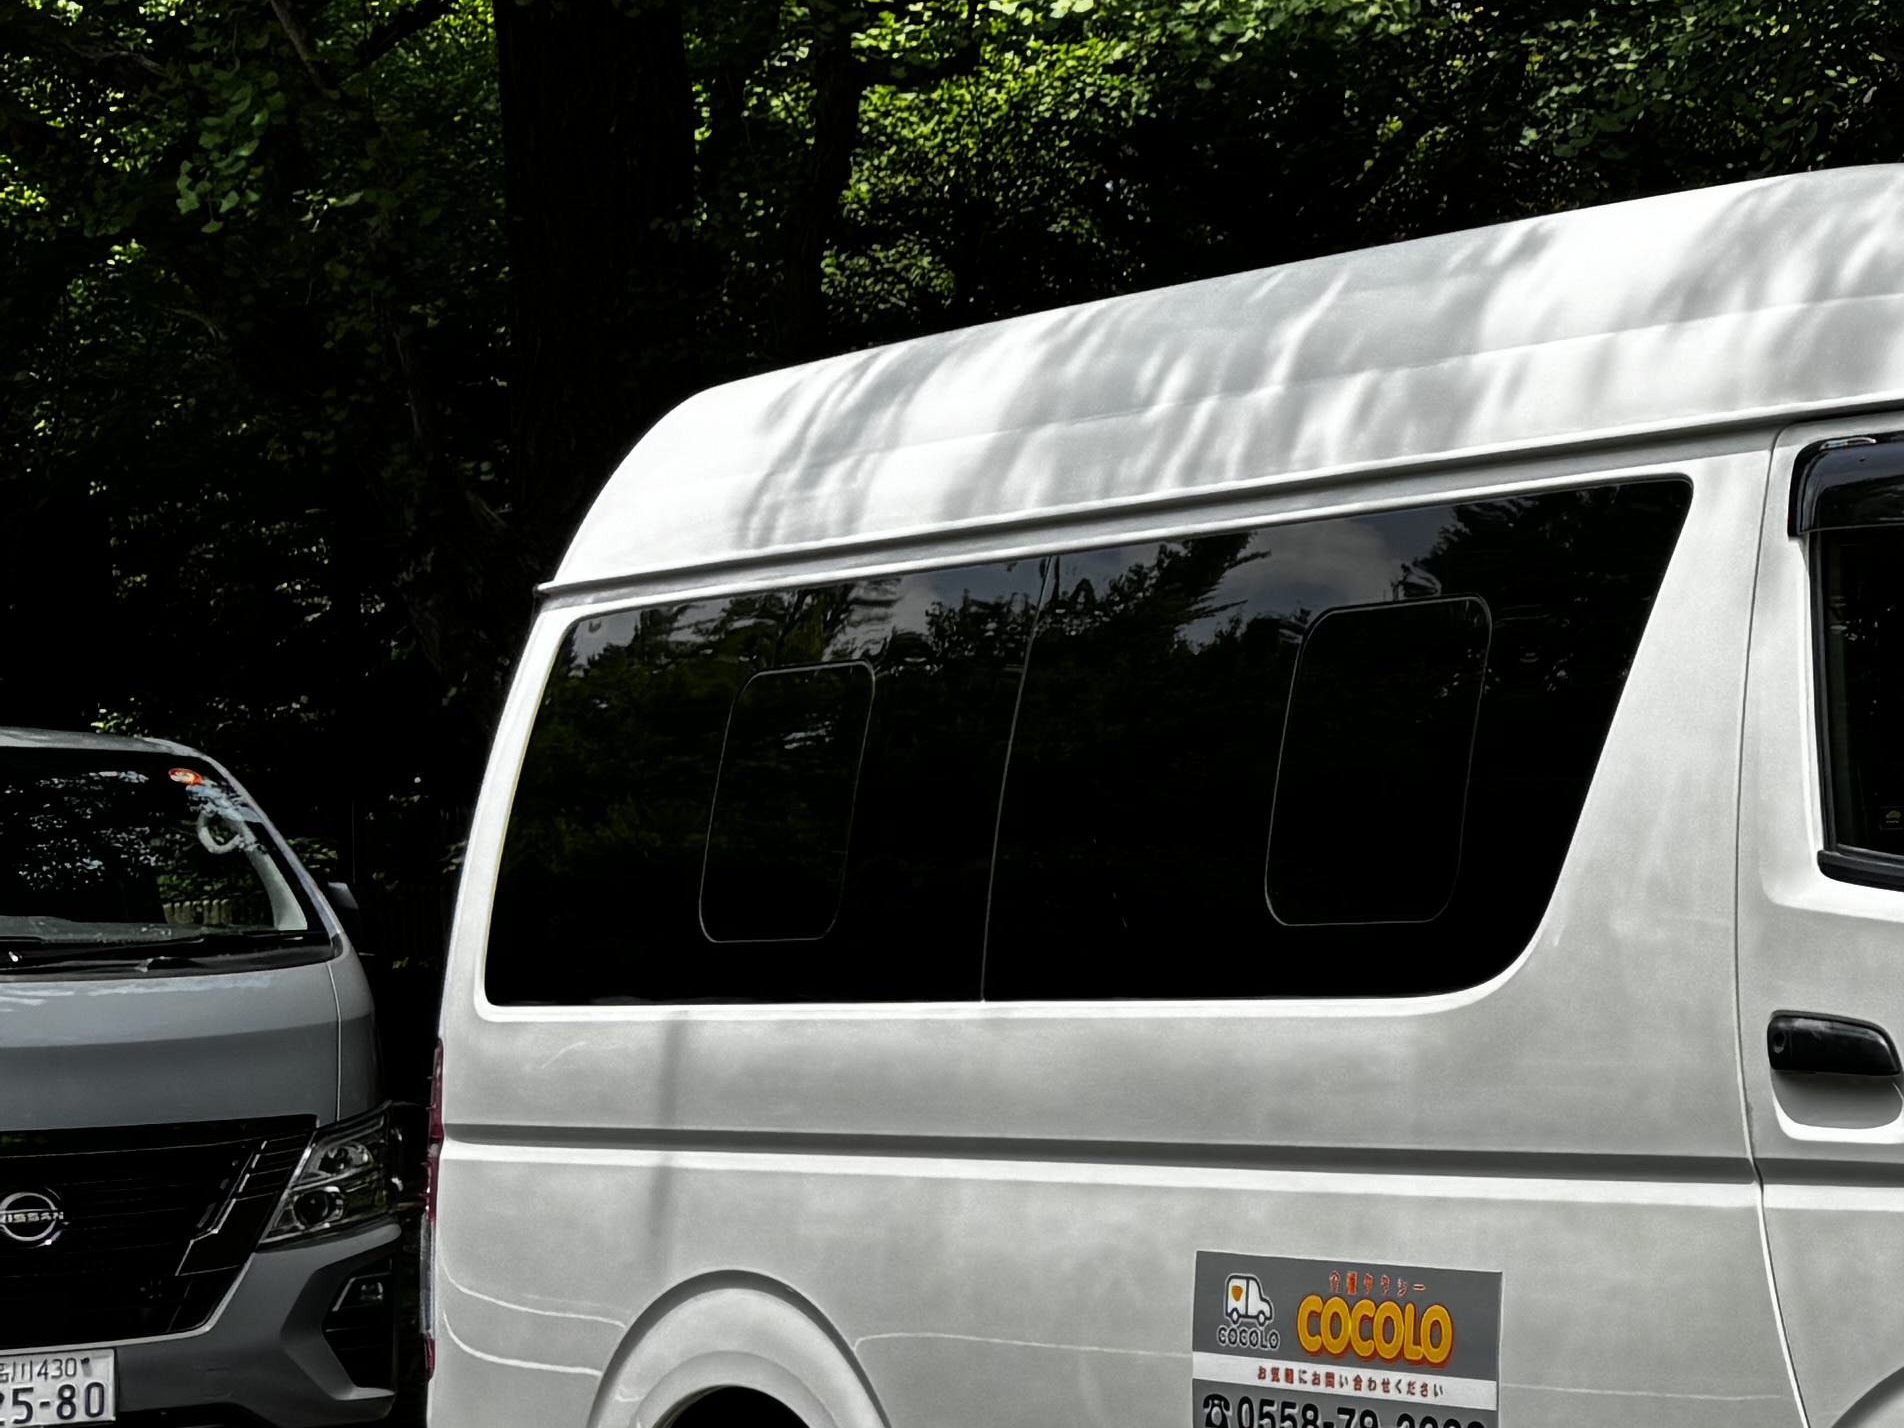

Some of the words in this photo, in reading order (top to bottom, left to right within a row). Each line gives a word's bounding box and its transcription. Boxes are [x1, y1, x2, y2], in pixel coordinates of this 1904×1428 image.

[1217, 1326, 1281, 1351] COCOLO
[1297, 1294, 1453, 1366] COCOLO
[1257, 1366, 1444, 1397] お気軽にお問い合わせください
[0, 1381, 104, 1425] 5-80
